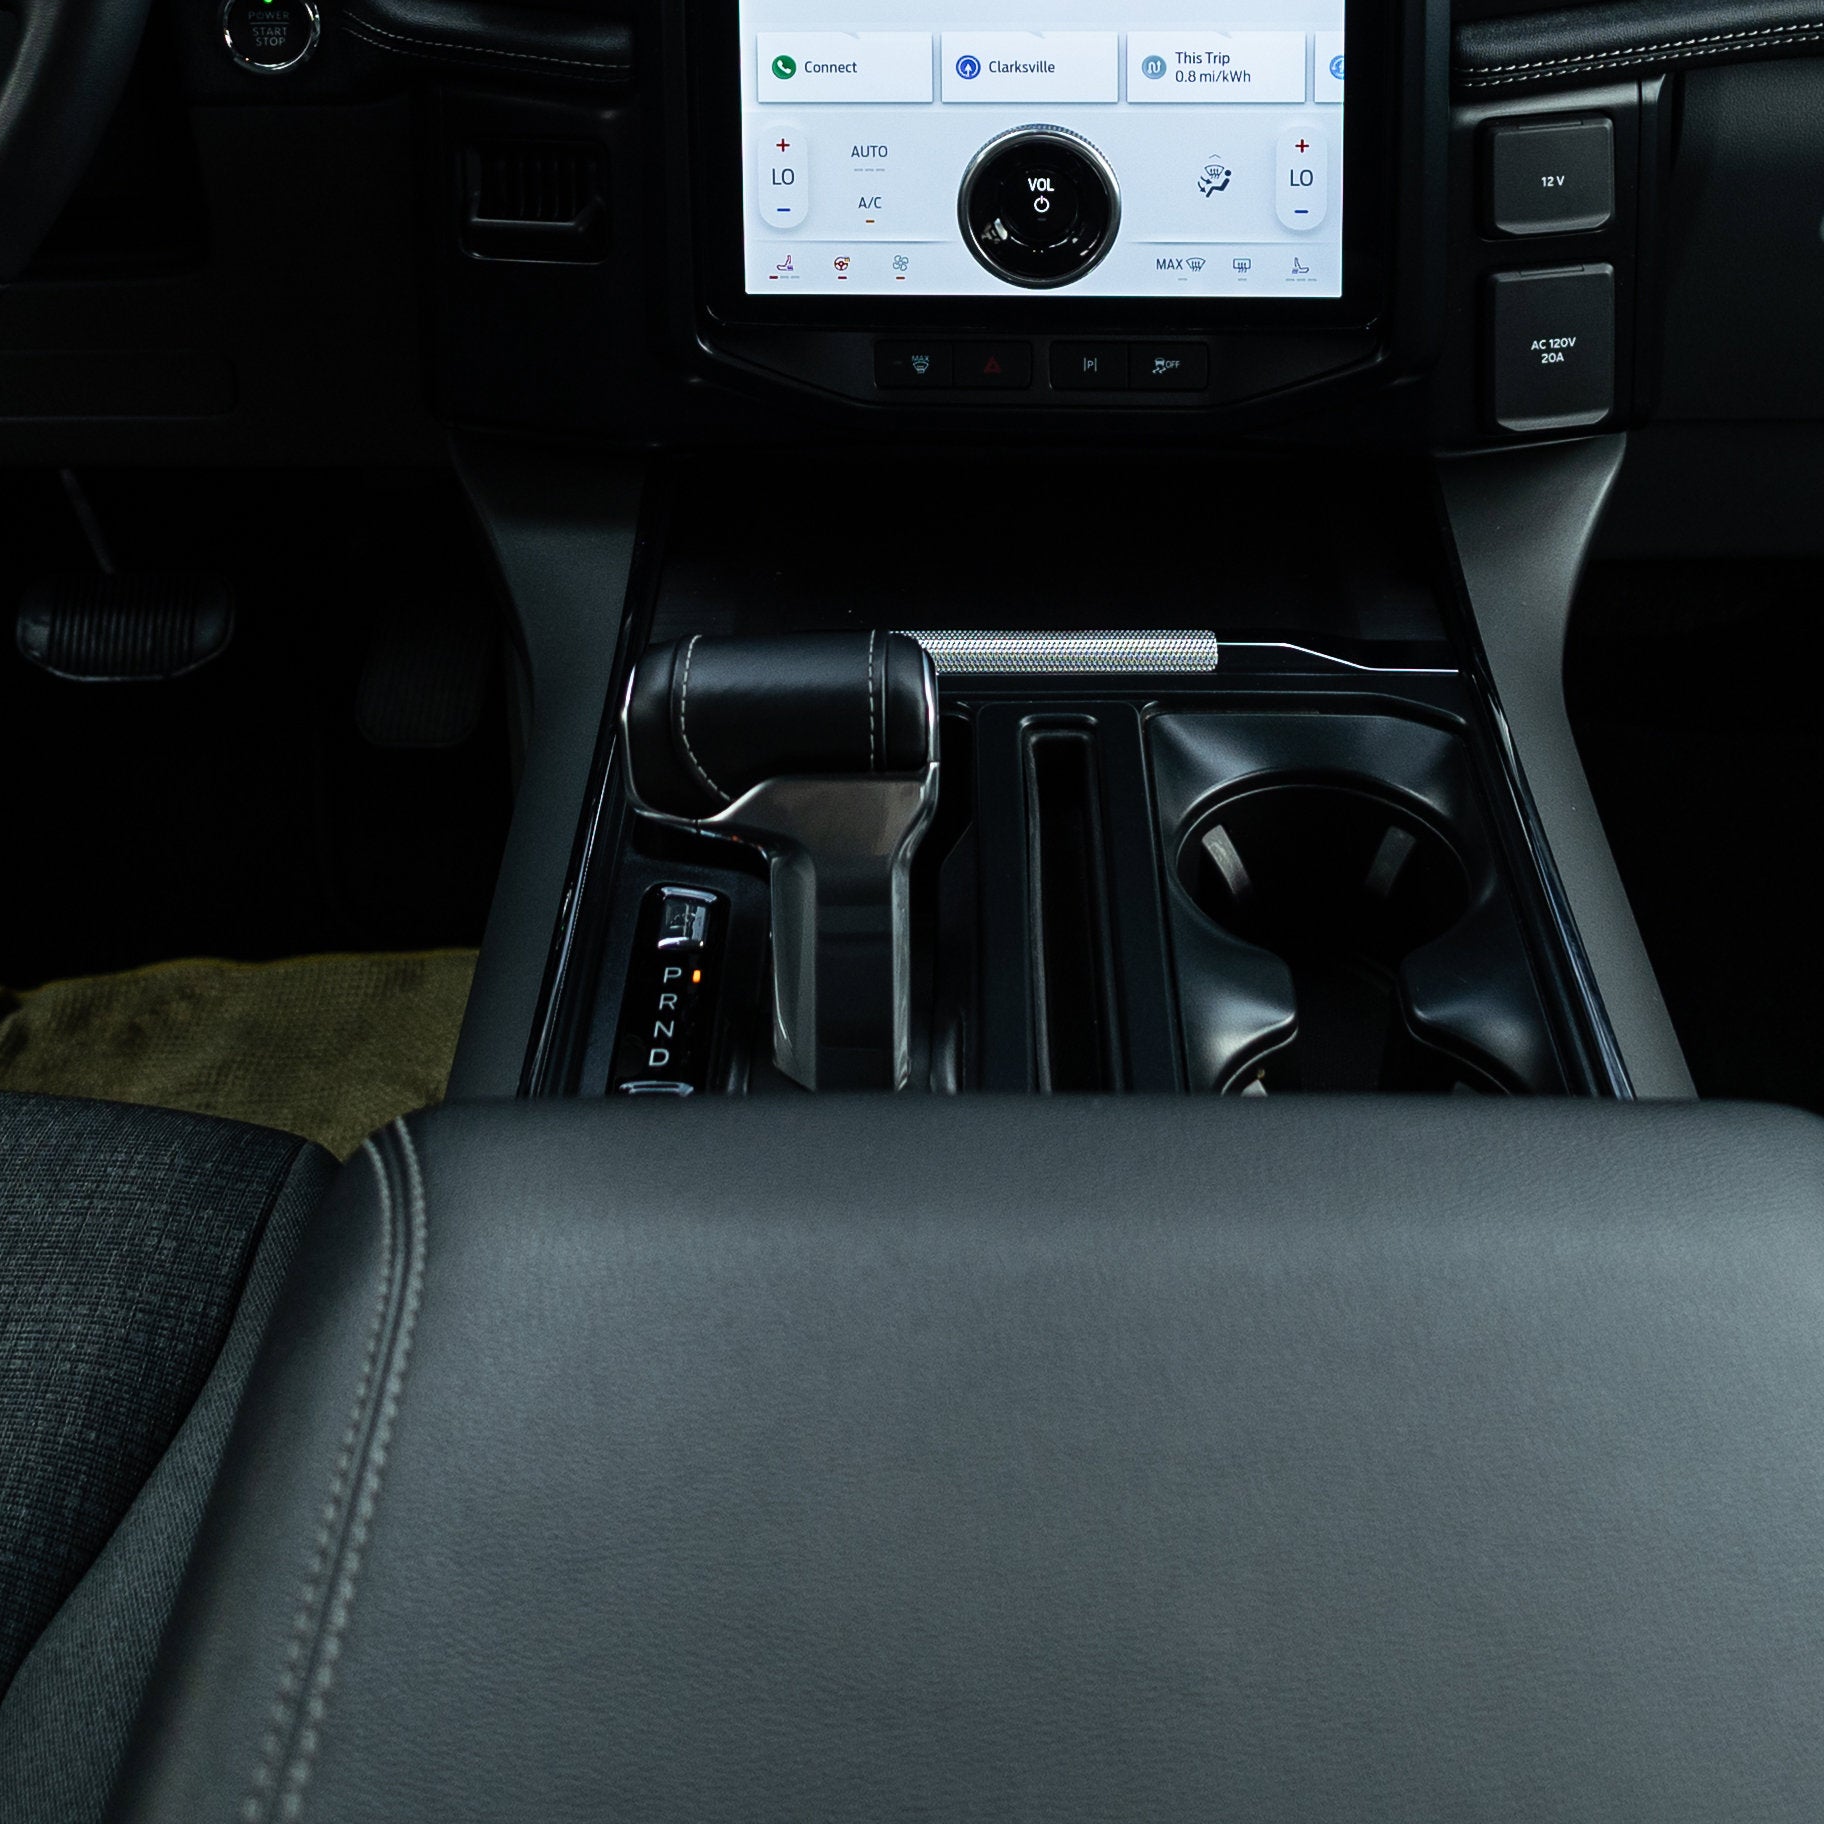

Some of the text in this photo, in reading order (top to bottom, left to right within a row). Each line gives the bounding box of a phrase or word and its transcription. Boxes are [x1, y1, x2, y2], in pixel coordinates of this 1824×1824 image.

[248, 11, 289, 21] POWER
[251, 26, 287, 37] START
[255, 36, 286, 46] STOP
[989, 57, 1055, 73] Clarksville
[1175, 50, 1231, 68] This Trip
[805, 61, 857, 73] Connect
[1176, 69, 1251, 84] 0.8 mi/kWh
[851, 145, 887, 157] AUTO
[773, 168, 794, 185] LO
[1291, 169, 1313, 186] LO
[1542, 176, 1564, 187] 12 V
[1027, 177, 1055, 192] VOL
[858, 197, 881, 210] A/C
[1157, 259, 1184, 270] MAX
[1531, 337, 1576, 350] AC 120V
[1542, 352, 1564, 363] 20A
[1165, 360, 1180, 369] OFF
[649, 967, 681, 1066] P R N D
